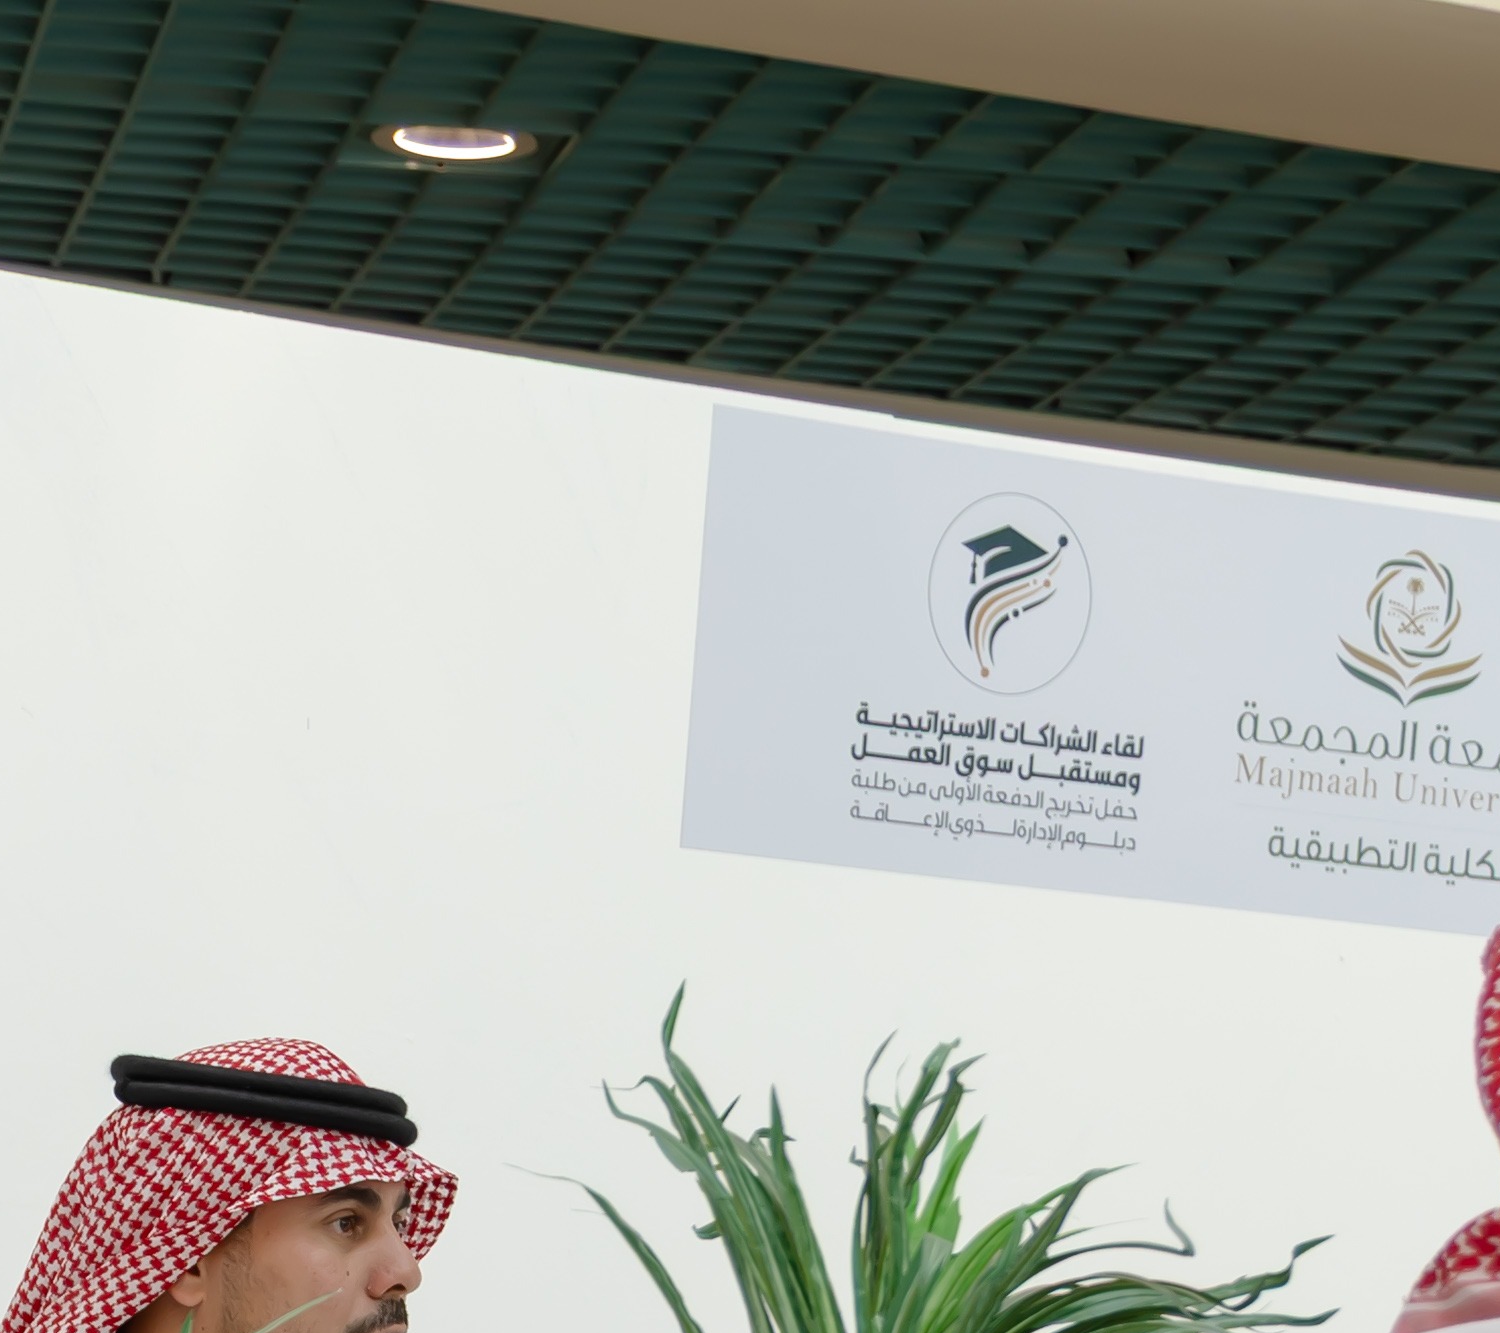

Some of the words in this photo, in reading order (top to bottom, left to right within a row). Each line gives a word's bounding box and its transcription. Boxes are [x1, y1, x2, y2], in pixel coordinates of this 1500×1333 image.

[856, 701, 996, 741] الاستراتيجية
[1237, 700, 1418, 766] المجمعة
[851, 733, 951, 767] العمل
[1000, 720, 1097, 756] الشراكات
[1101, 734, 1144, 759] لقاء
[955, 746, 1013, 778] سوق
[1018, 753, 1142, 795] ومستقبل
[1234, 752, 1379, 800] Majmaah
[851, 768, 896, 795] طلبة
[899, 775, 927, 798] من
[929, 775, 981, 806] الأولى
[982, 786, 1044, 809] الدفعة
[1044, 796, 1094, 820] تخريج
[1095, 799, 1138, 821] حفل
[850, 799, 949, 837] الإعاقة
[1016, 819, 1062, 850] الإدارة
[1060, 828, 1137, 856] دبلوم
[1268, 825, 1417, 875] التطبيقية
